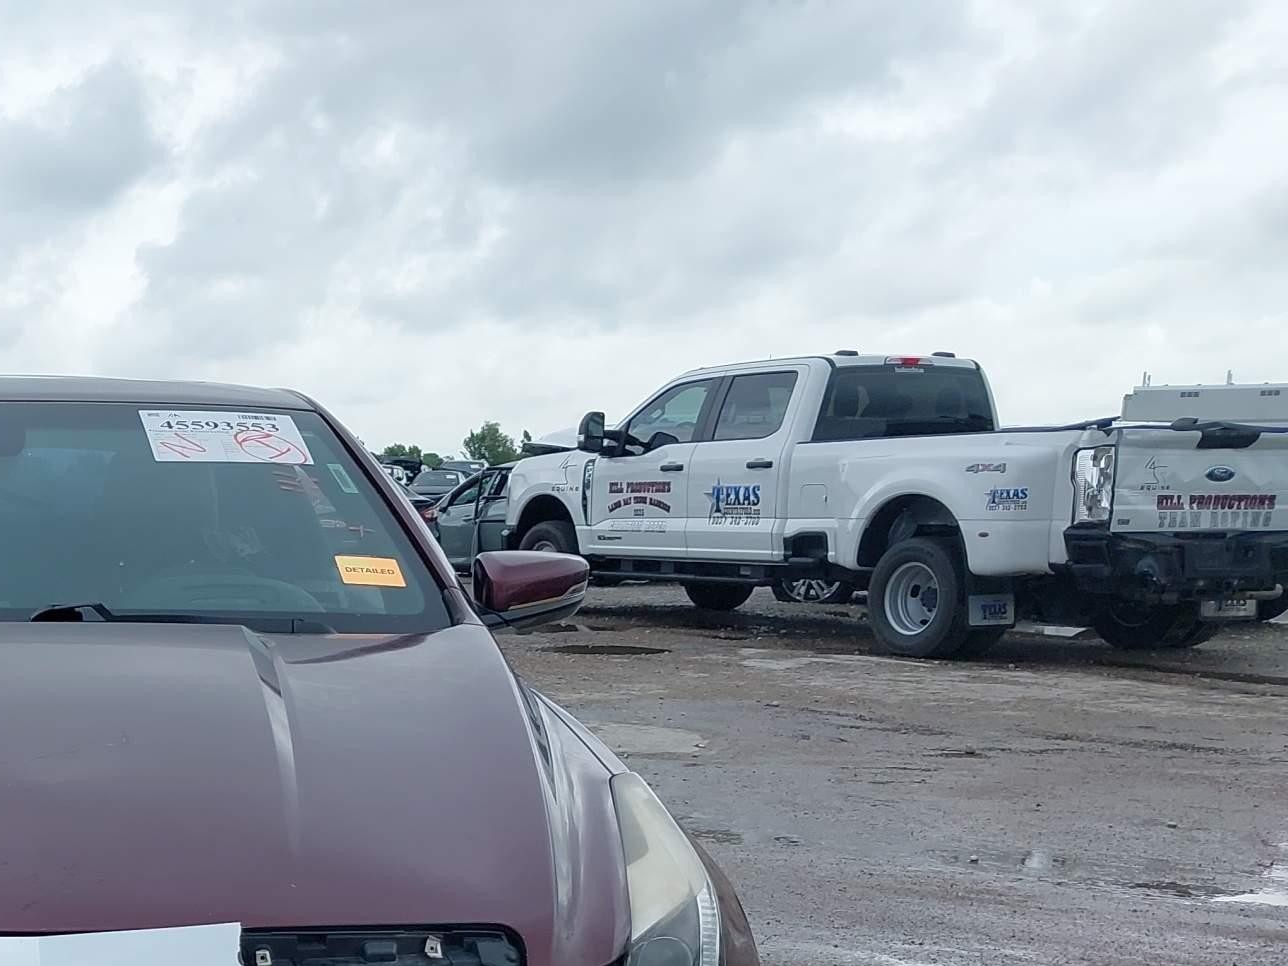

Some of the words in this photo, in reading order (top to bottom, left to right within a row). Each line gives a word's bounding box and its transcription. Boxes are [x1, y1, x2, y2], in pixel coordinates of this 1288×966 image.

[160, 420, 279, 433] 45593553
[712, 484, 761, 513] TEXAS
[989, 487, 1029, 505] TEXAS
[1156, 494, 1185, 511] HILL
[1189, 494, 1277, 511] PRODUCTIONS
[1158, 511, 1202, 528] TEAM
[1210, 511, 1273, 528] ROPING
[344, 565, 396, 576] DETAILED
